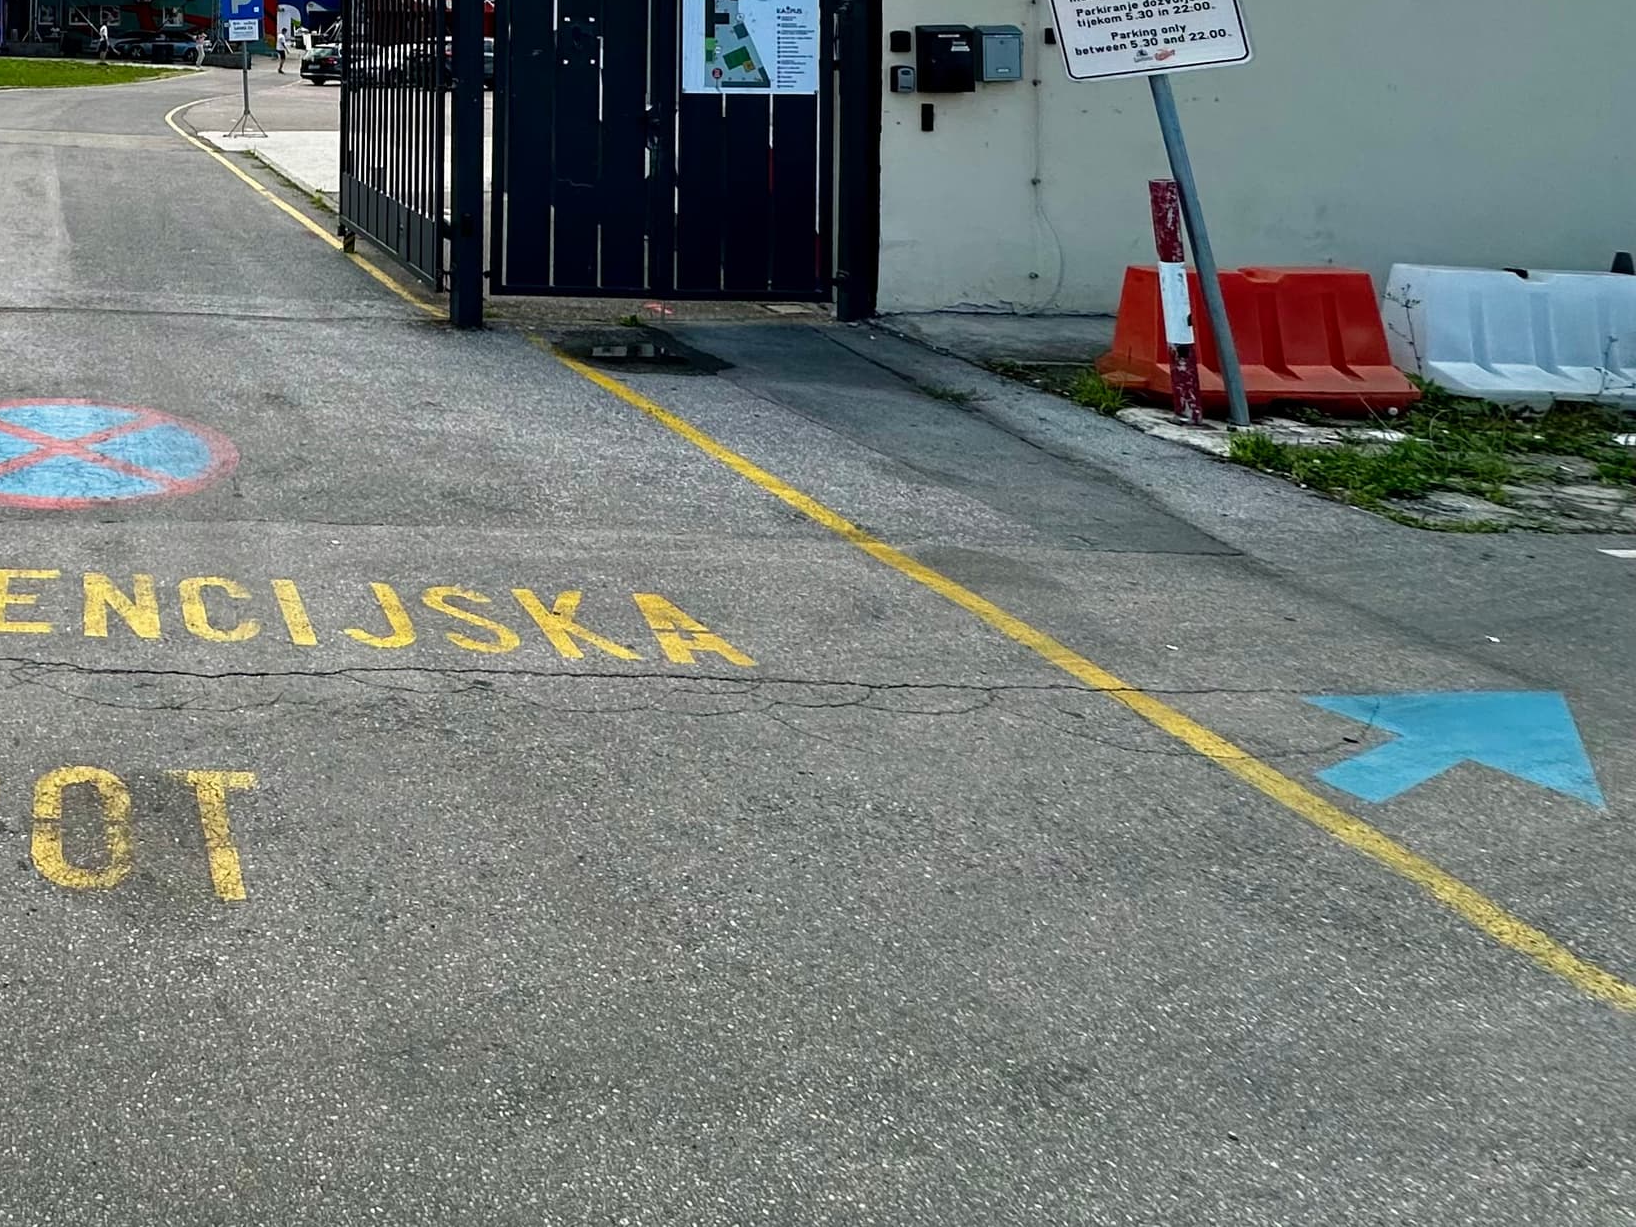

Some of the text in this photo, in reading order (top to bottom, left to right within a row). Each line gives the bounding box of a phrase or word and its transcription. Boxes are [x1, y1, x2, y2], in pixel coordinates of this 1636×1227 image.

[1075, 1, 1139, 17] Parkiranje
[1076, 15, 1122, 28] tijekom
[1125, 9, 1153, 21] 5.30
[1158, 8, 1169, 16] in
[1110, 24, 1186, 41] Parking only
[1075, 43, 1127, 56] between
[1129, 38, 1158, 48] 5.30
[1163, 34, 1185, 44] and
